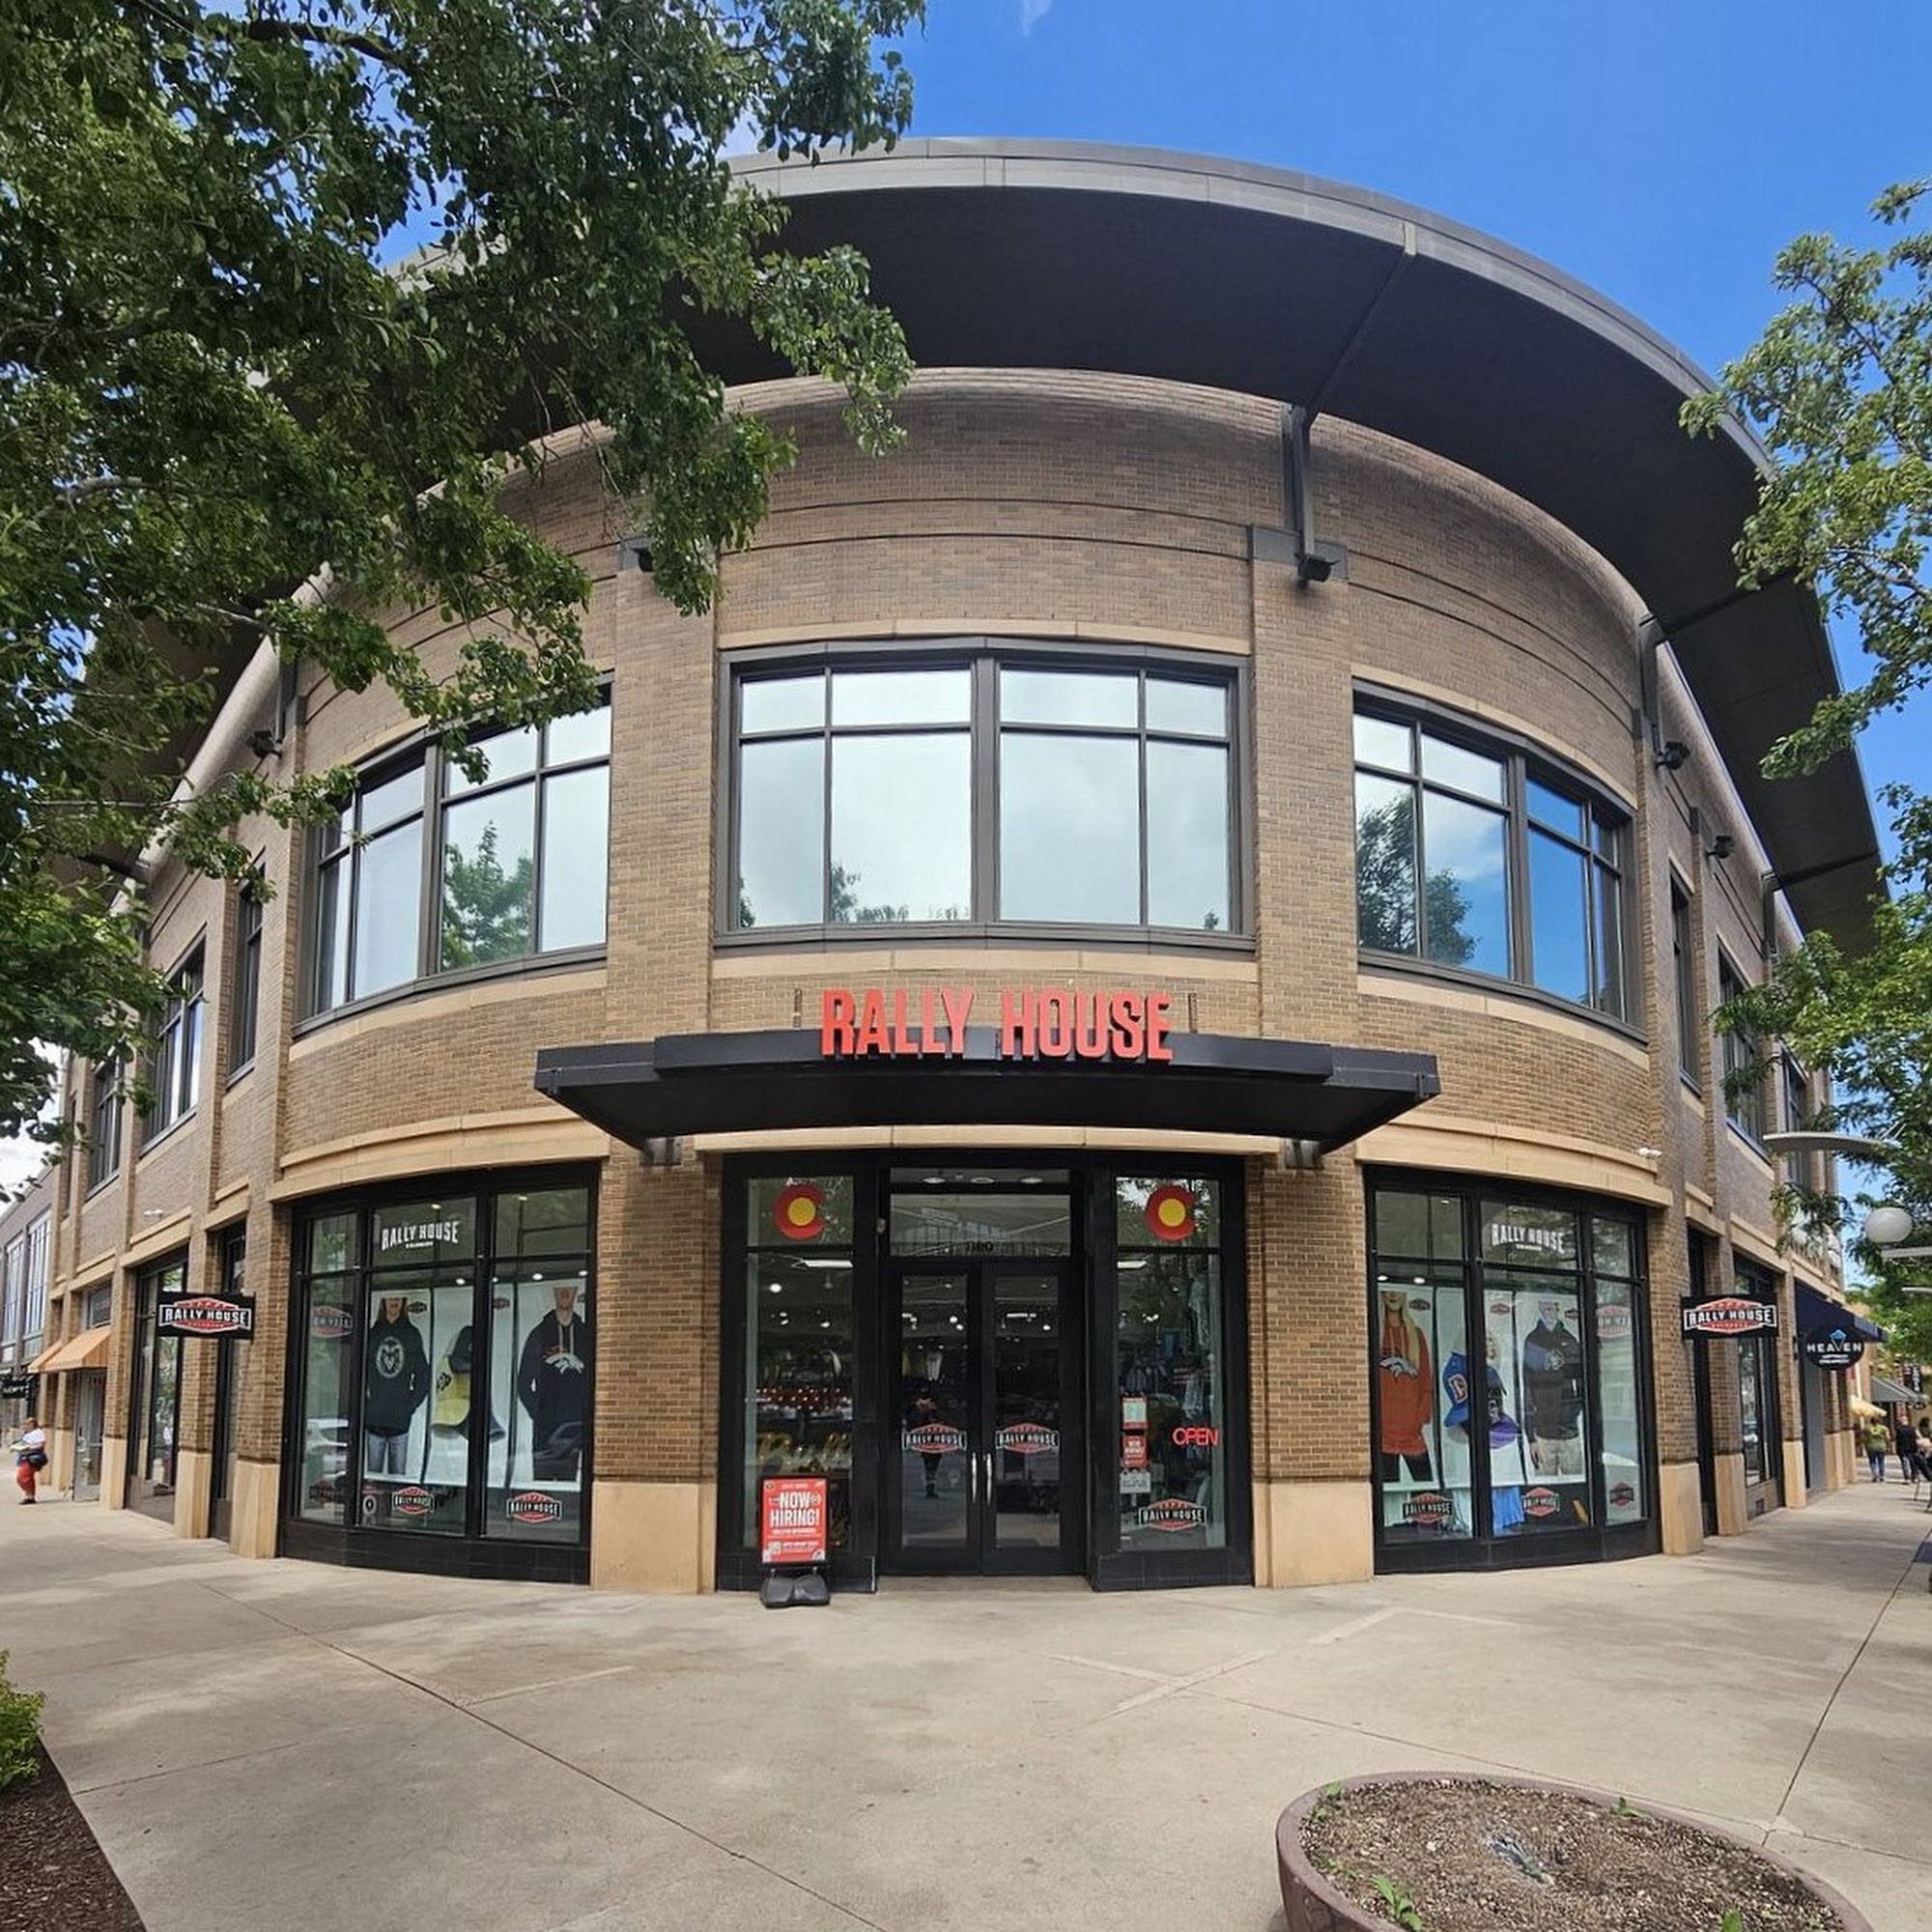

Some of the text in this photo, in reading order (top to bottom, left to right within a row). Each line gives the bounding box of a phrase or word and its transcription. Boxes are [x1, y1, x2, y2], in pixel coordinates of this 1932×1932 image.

[821, 988, 1176, 1062] RALLY HOUSE
[382, 1220, 460, 1251] RALLY HOUSE
[1492, 1223, 1565, 1255] RALLY HOUSE
[165, 1308, 203, 1321] RALLY
[207, 1310, 246, 1325] HOUSE
[1689, 1311, 1725, 1325] RALLY
[1729, 1309, 1772, 1322] HOUSE
[1806, 1341, 1862, 1352] HEAVEN
[905, 1434, 962, 1448] RALLY HOUSE
[999, 1433, 1057, 1446] RALLY HOUSE
[1172, 1427, 1219, 1446] OPEN
[779, 1492, 810, 1509] NOW
[770, 1508, 821, 1526] HIRING!
[1143, 1509, 1203, 1522] RALLY HOUSE
